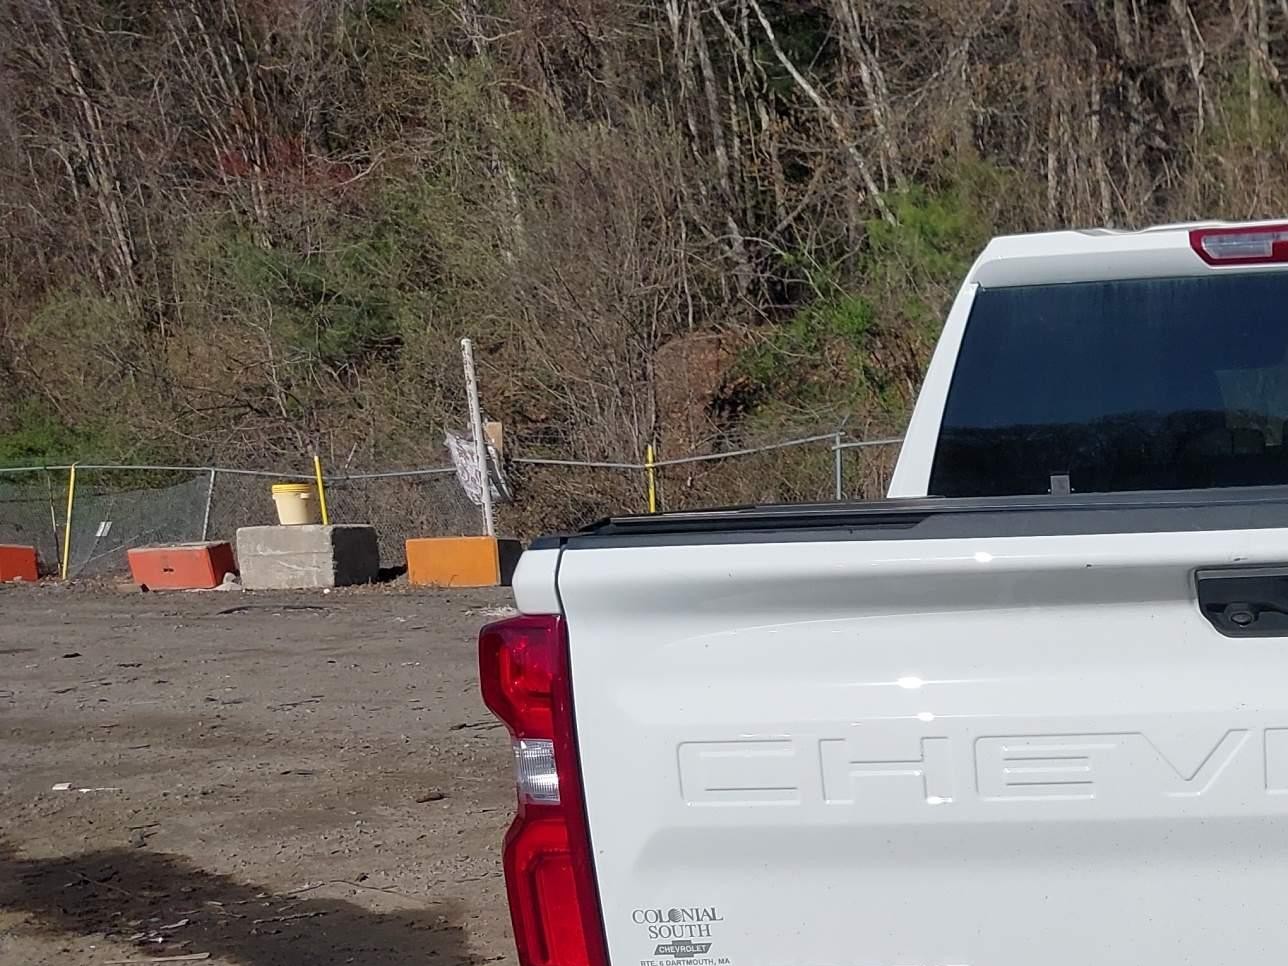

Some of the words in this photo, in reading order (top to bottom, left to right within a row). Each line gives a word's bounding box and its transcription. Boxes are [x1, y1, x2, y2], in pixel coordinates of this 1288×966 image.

[632, 907, 724, 924] COLONIAL
[648, 924, 712, 939] SOUTH
[665, 958, 717, 966] DARTMOUTH,
[718, 957, 730, 965] MA
